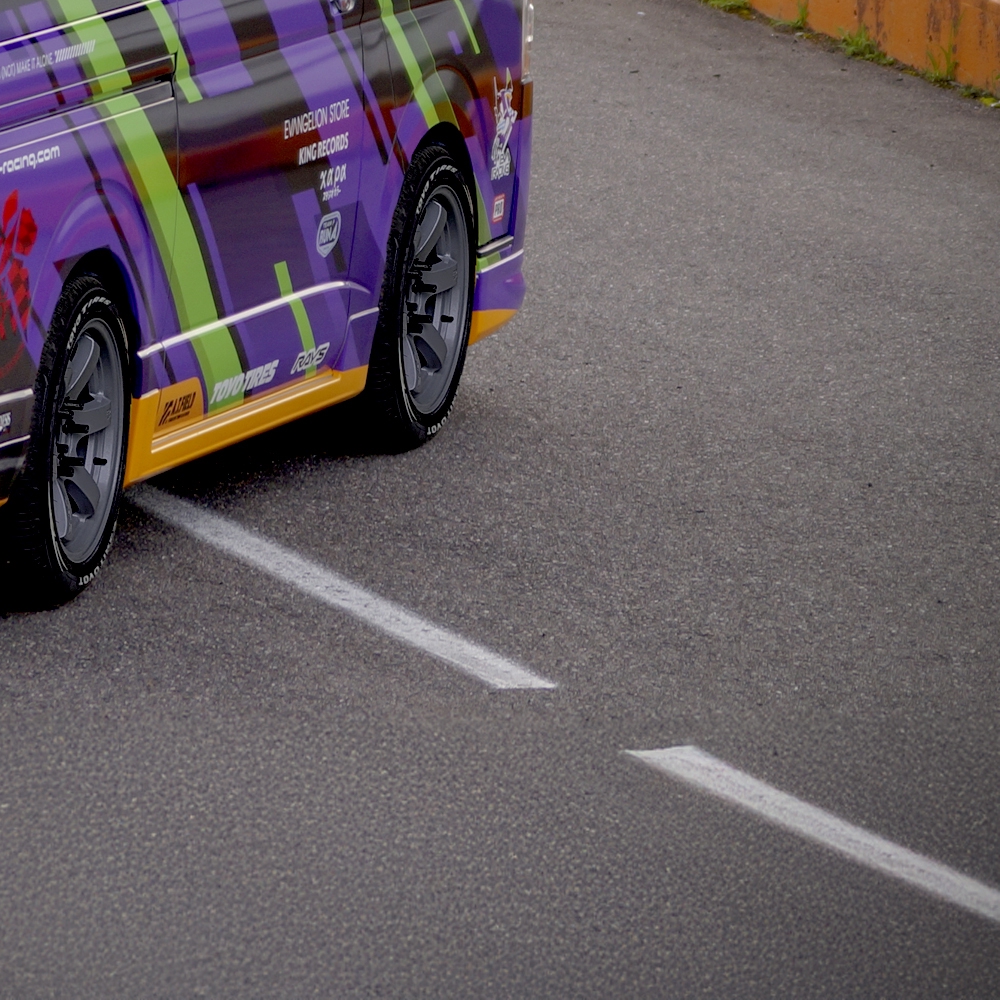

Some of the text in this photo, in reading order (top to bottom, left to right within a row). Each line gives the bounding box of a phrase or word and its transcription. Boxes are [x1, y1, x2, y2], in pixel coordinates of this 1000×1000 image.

[16, 59, 31, 75] MAKE
[284, 99, 350, 140] EVANGELION STORE
[298, 132, 349, 166] KING RECORDS
[290, 342, 330, 375] RAYS
[209, 359, 280, 405] TOYO TIRES
